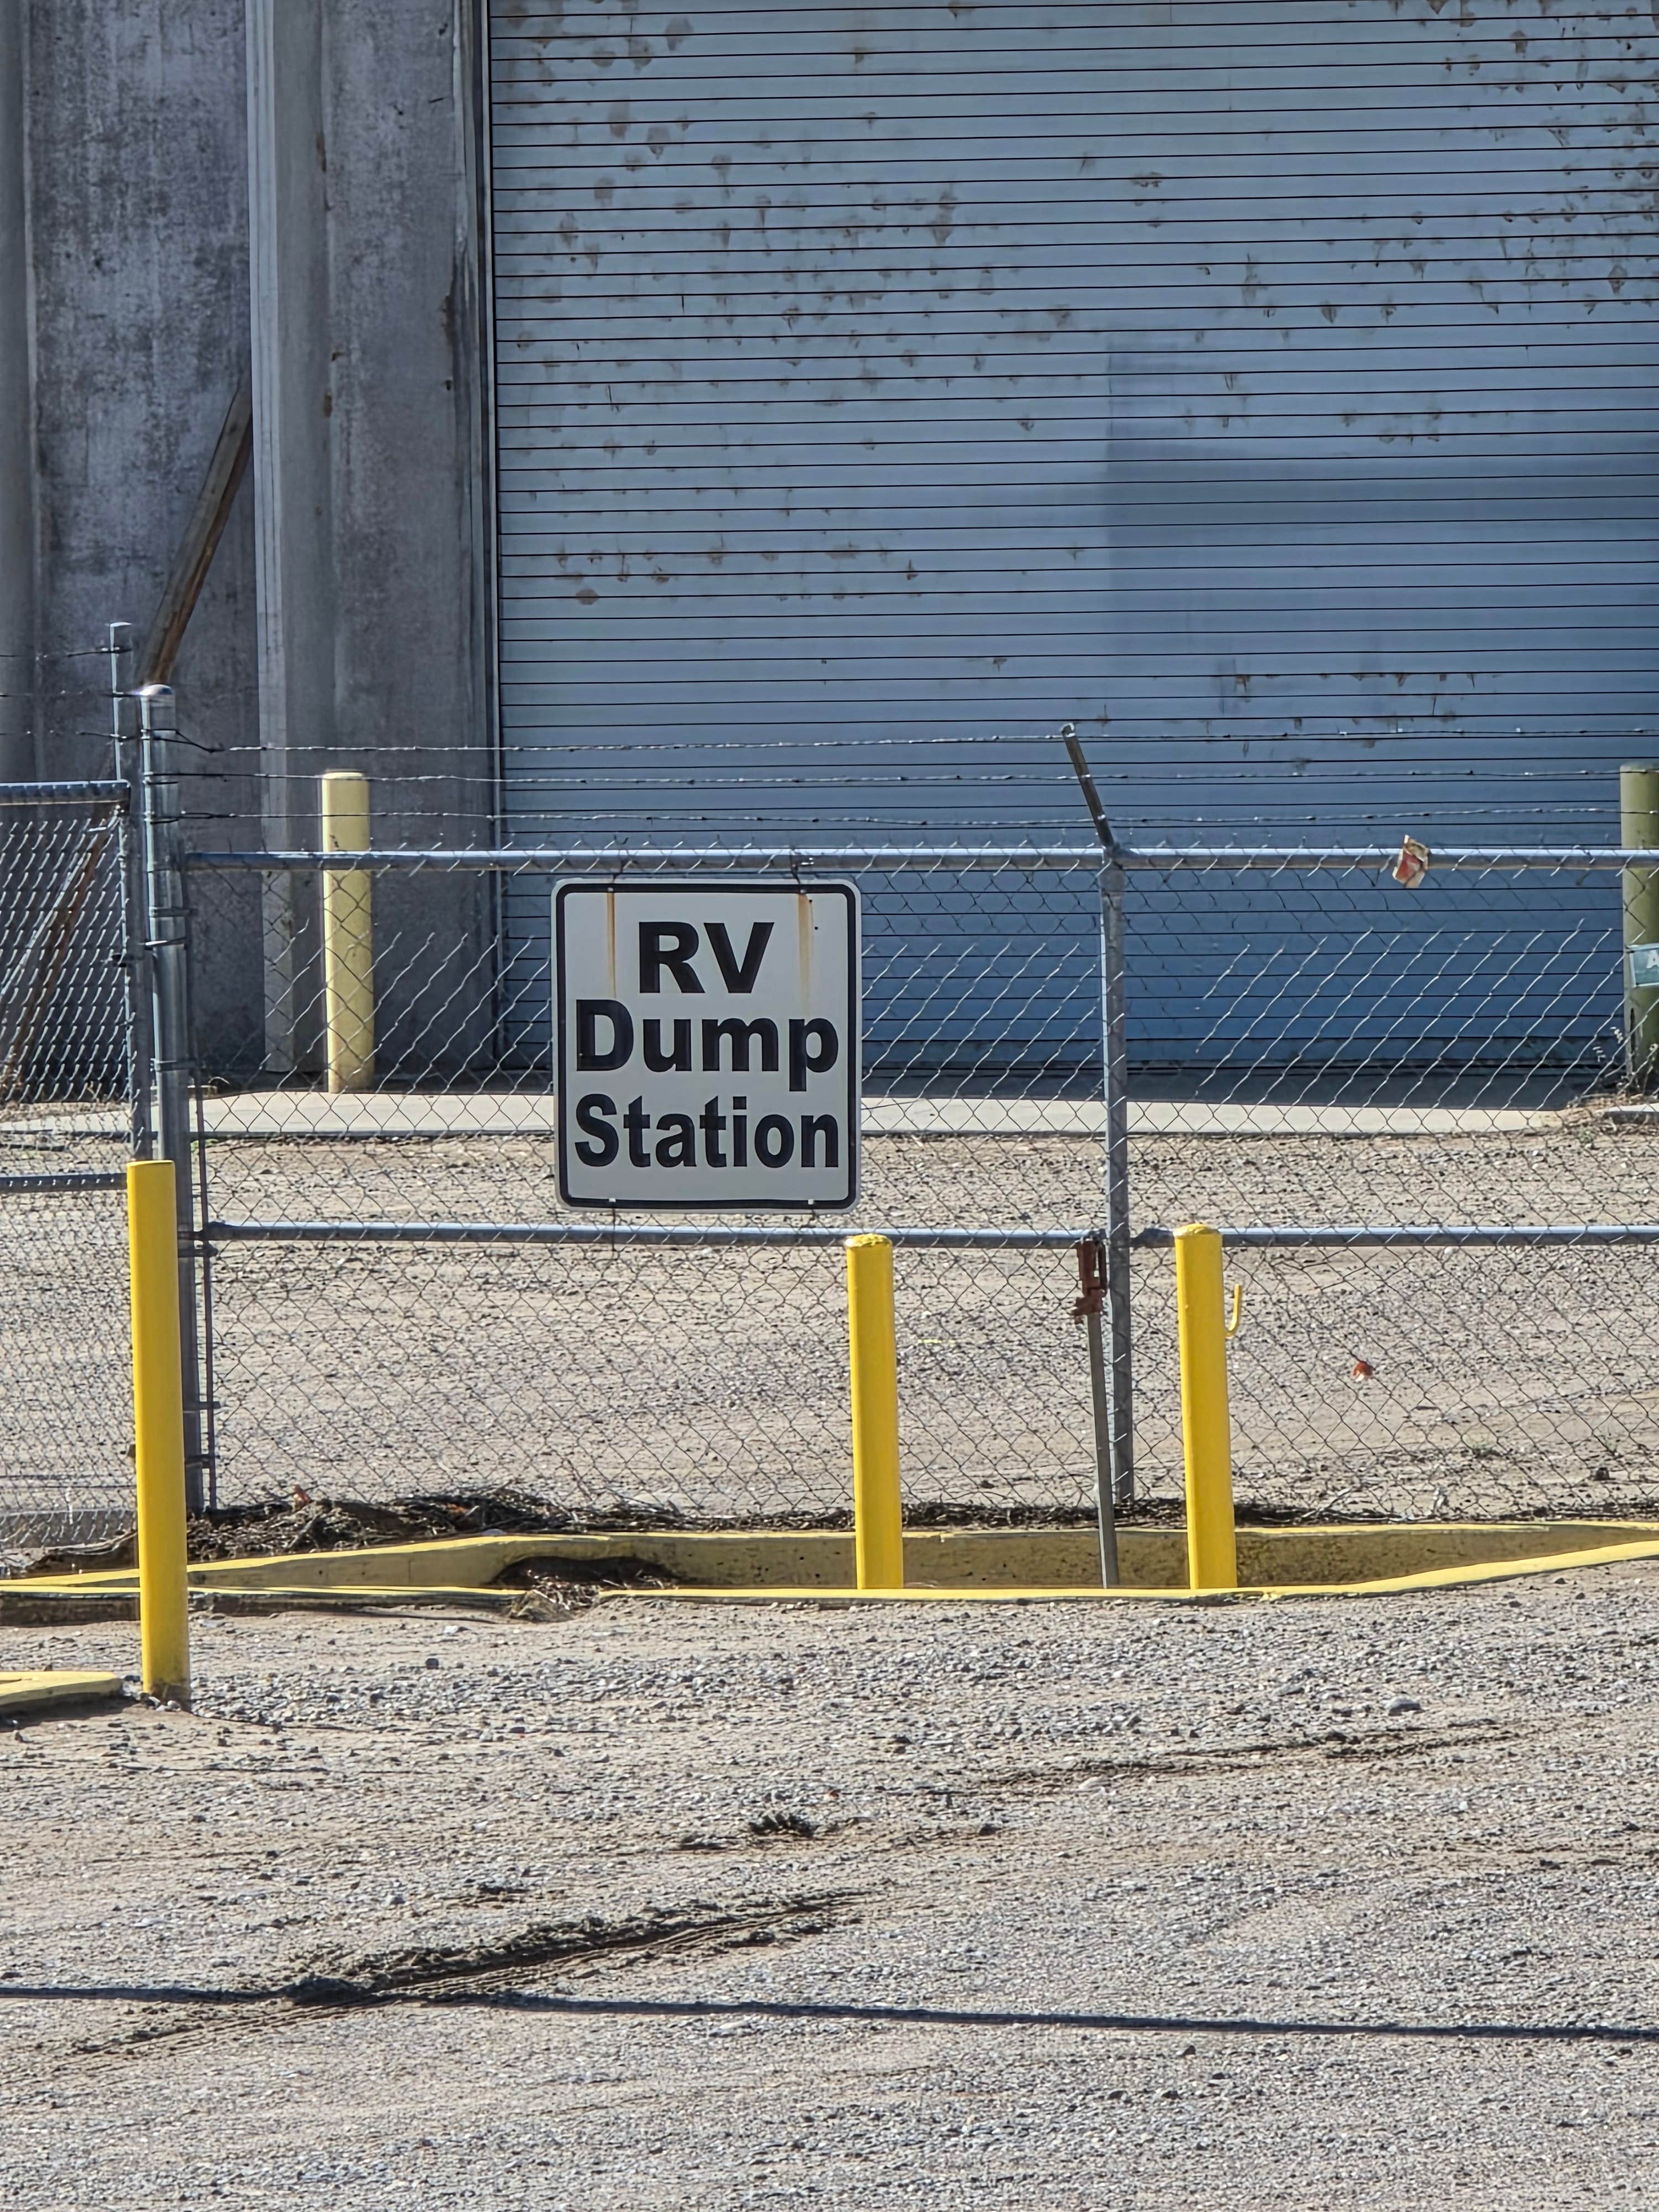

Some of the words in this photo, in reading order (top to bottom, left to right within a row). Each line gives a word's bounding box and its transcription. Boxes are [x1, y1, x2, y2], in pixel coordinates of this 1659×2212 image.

[639, 921, 774, 994] RV
[576, 999, 839, 1092] Dump
[575, 1093, 839, 1168] Station
